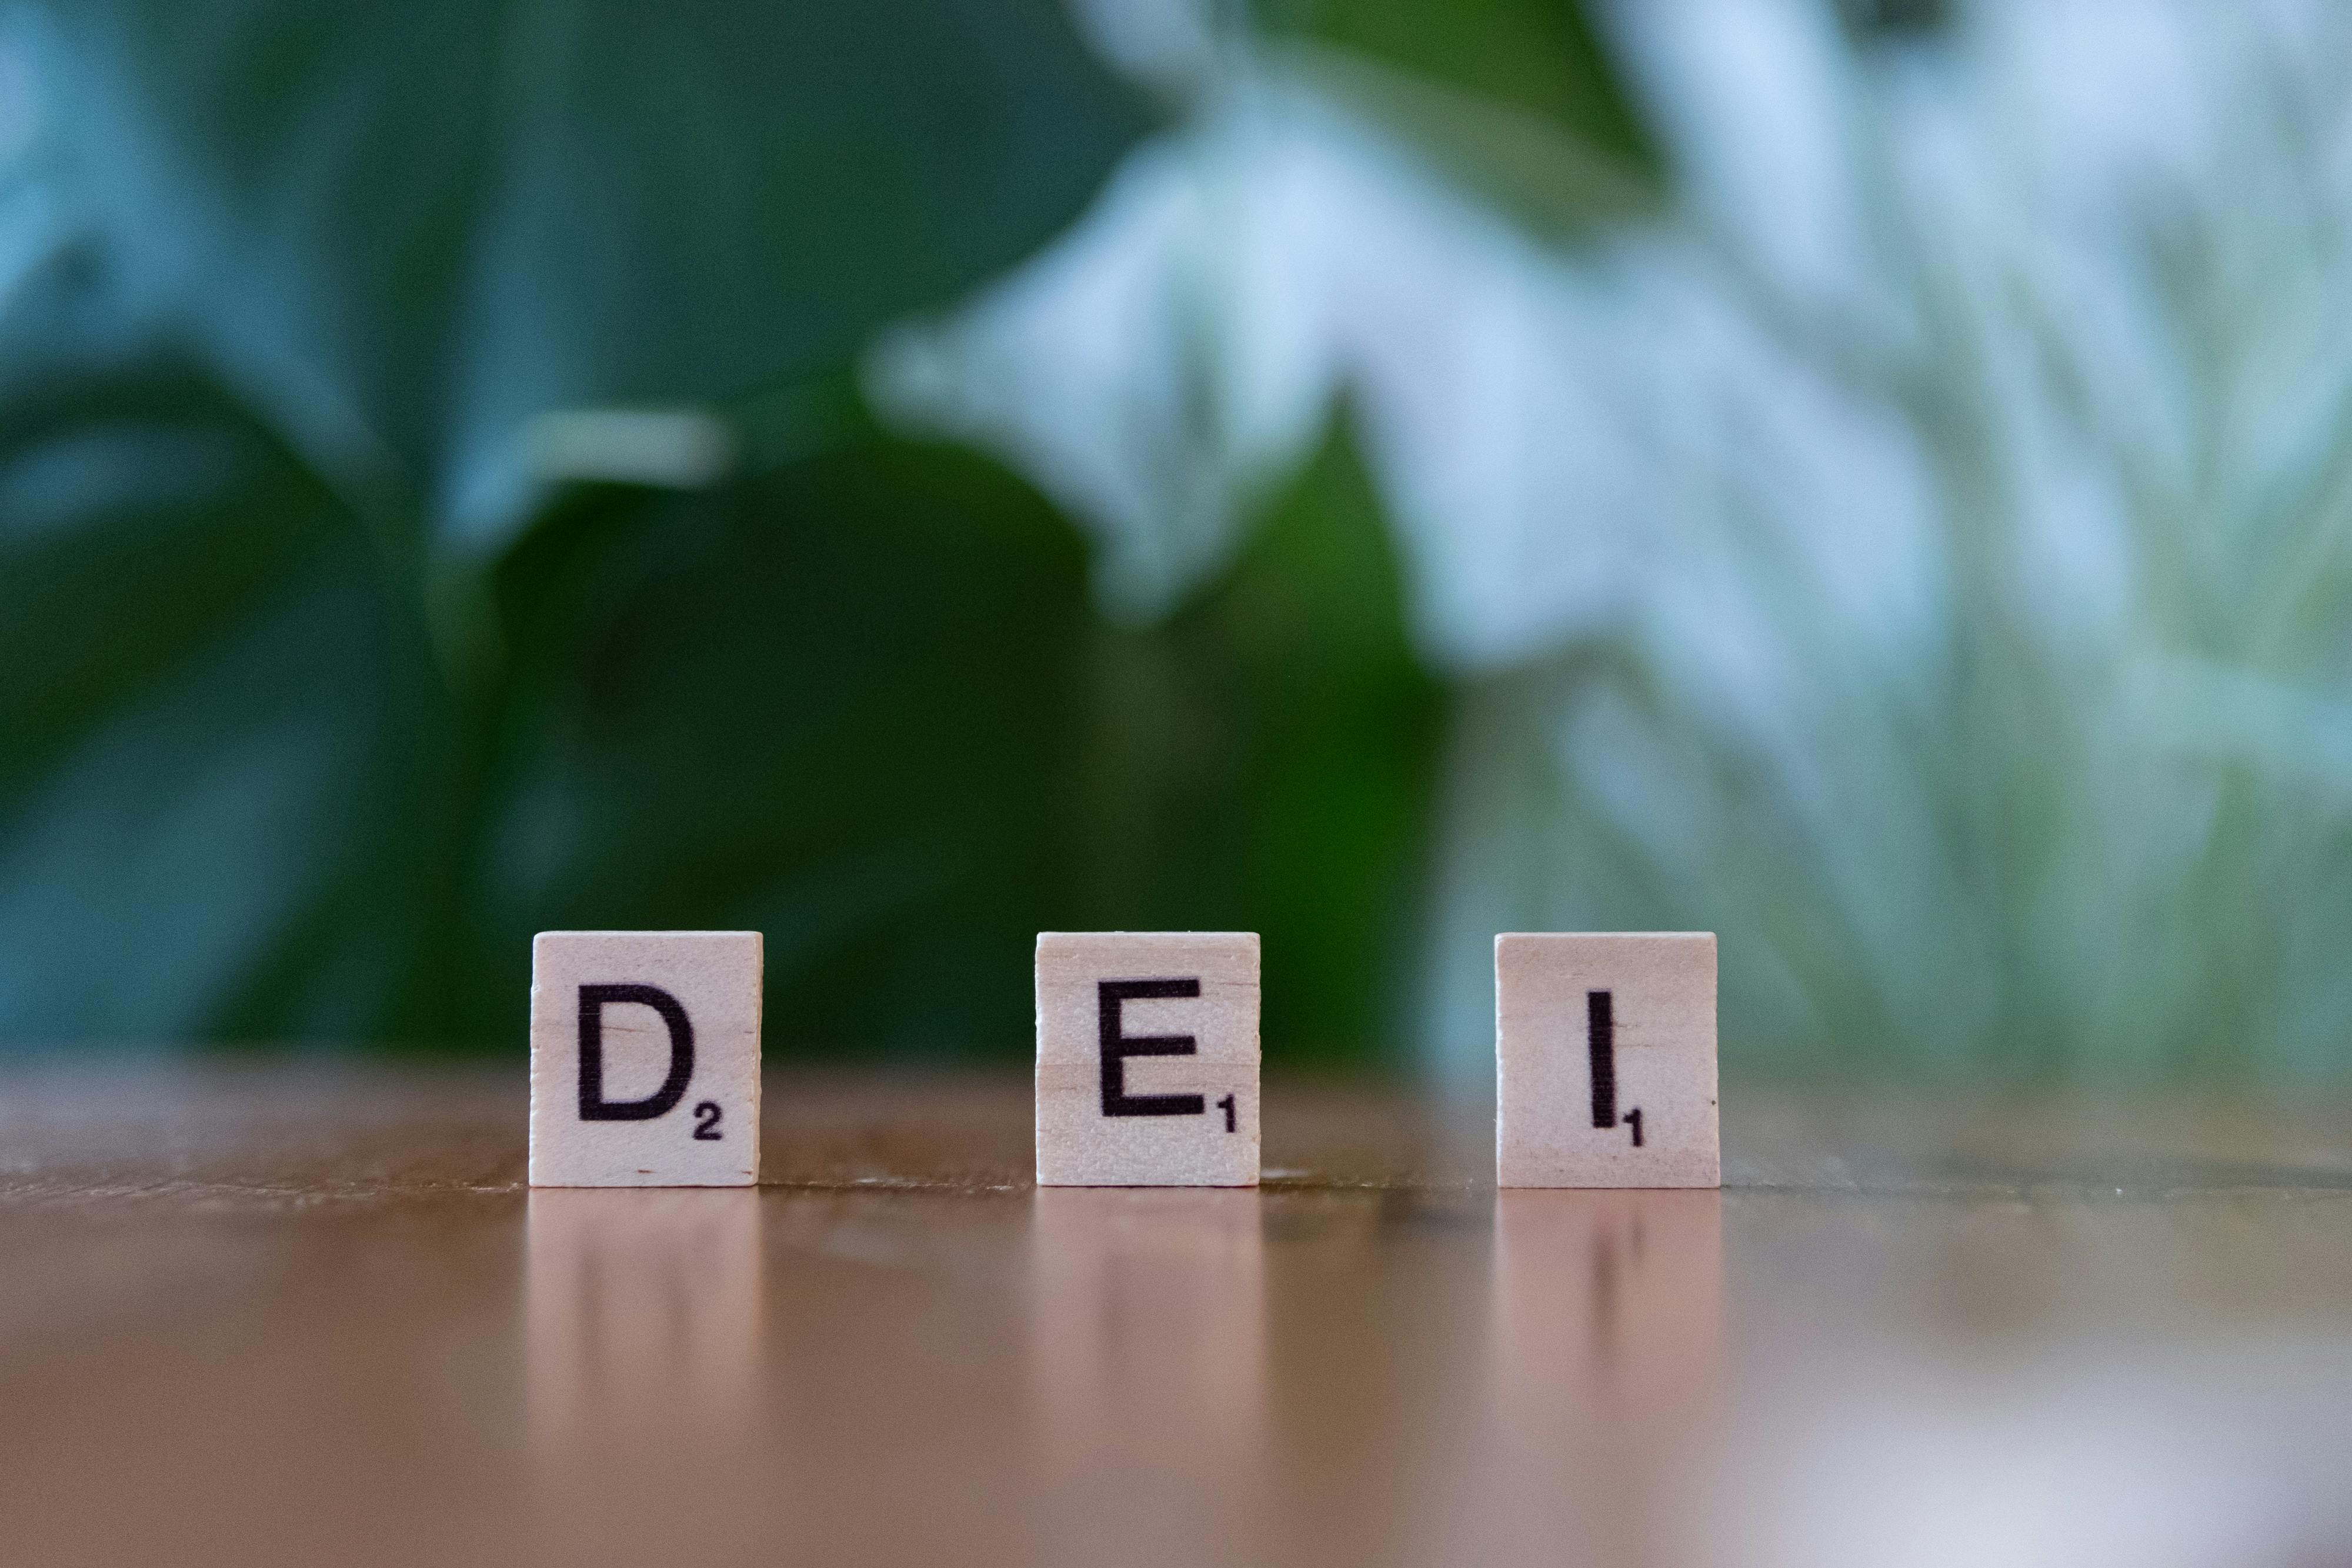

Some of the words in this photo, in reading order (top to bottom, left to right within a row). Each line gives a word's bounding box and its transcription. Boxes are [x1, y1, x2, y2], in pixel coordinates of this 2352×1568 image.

[577, 983, 696, 1122] D
[1097, 978, 1206, 1117] E
[1587, 990, 1617, 1129] I
[692, 1100, 723, 1141] 2
[1216, 1093, 1237, 1134] 1
[1622, 1107, 1645, 1149] 1
